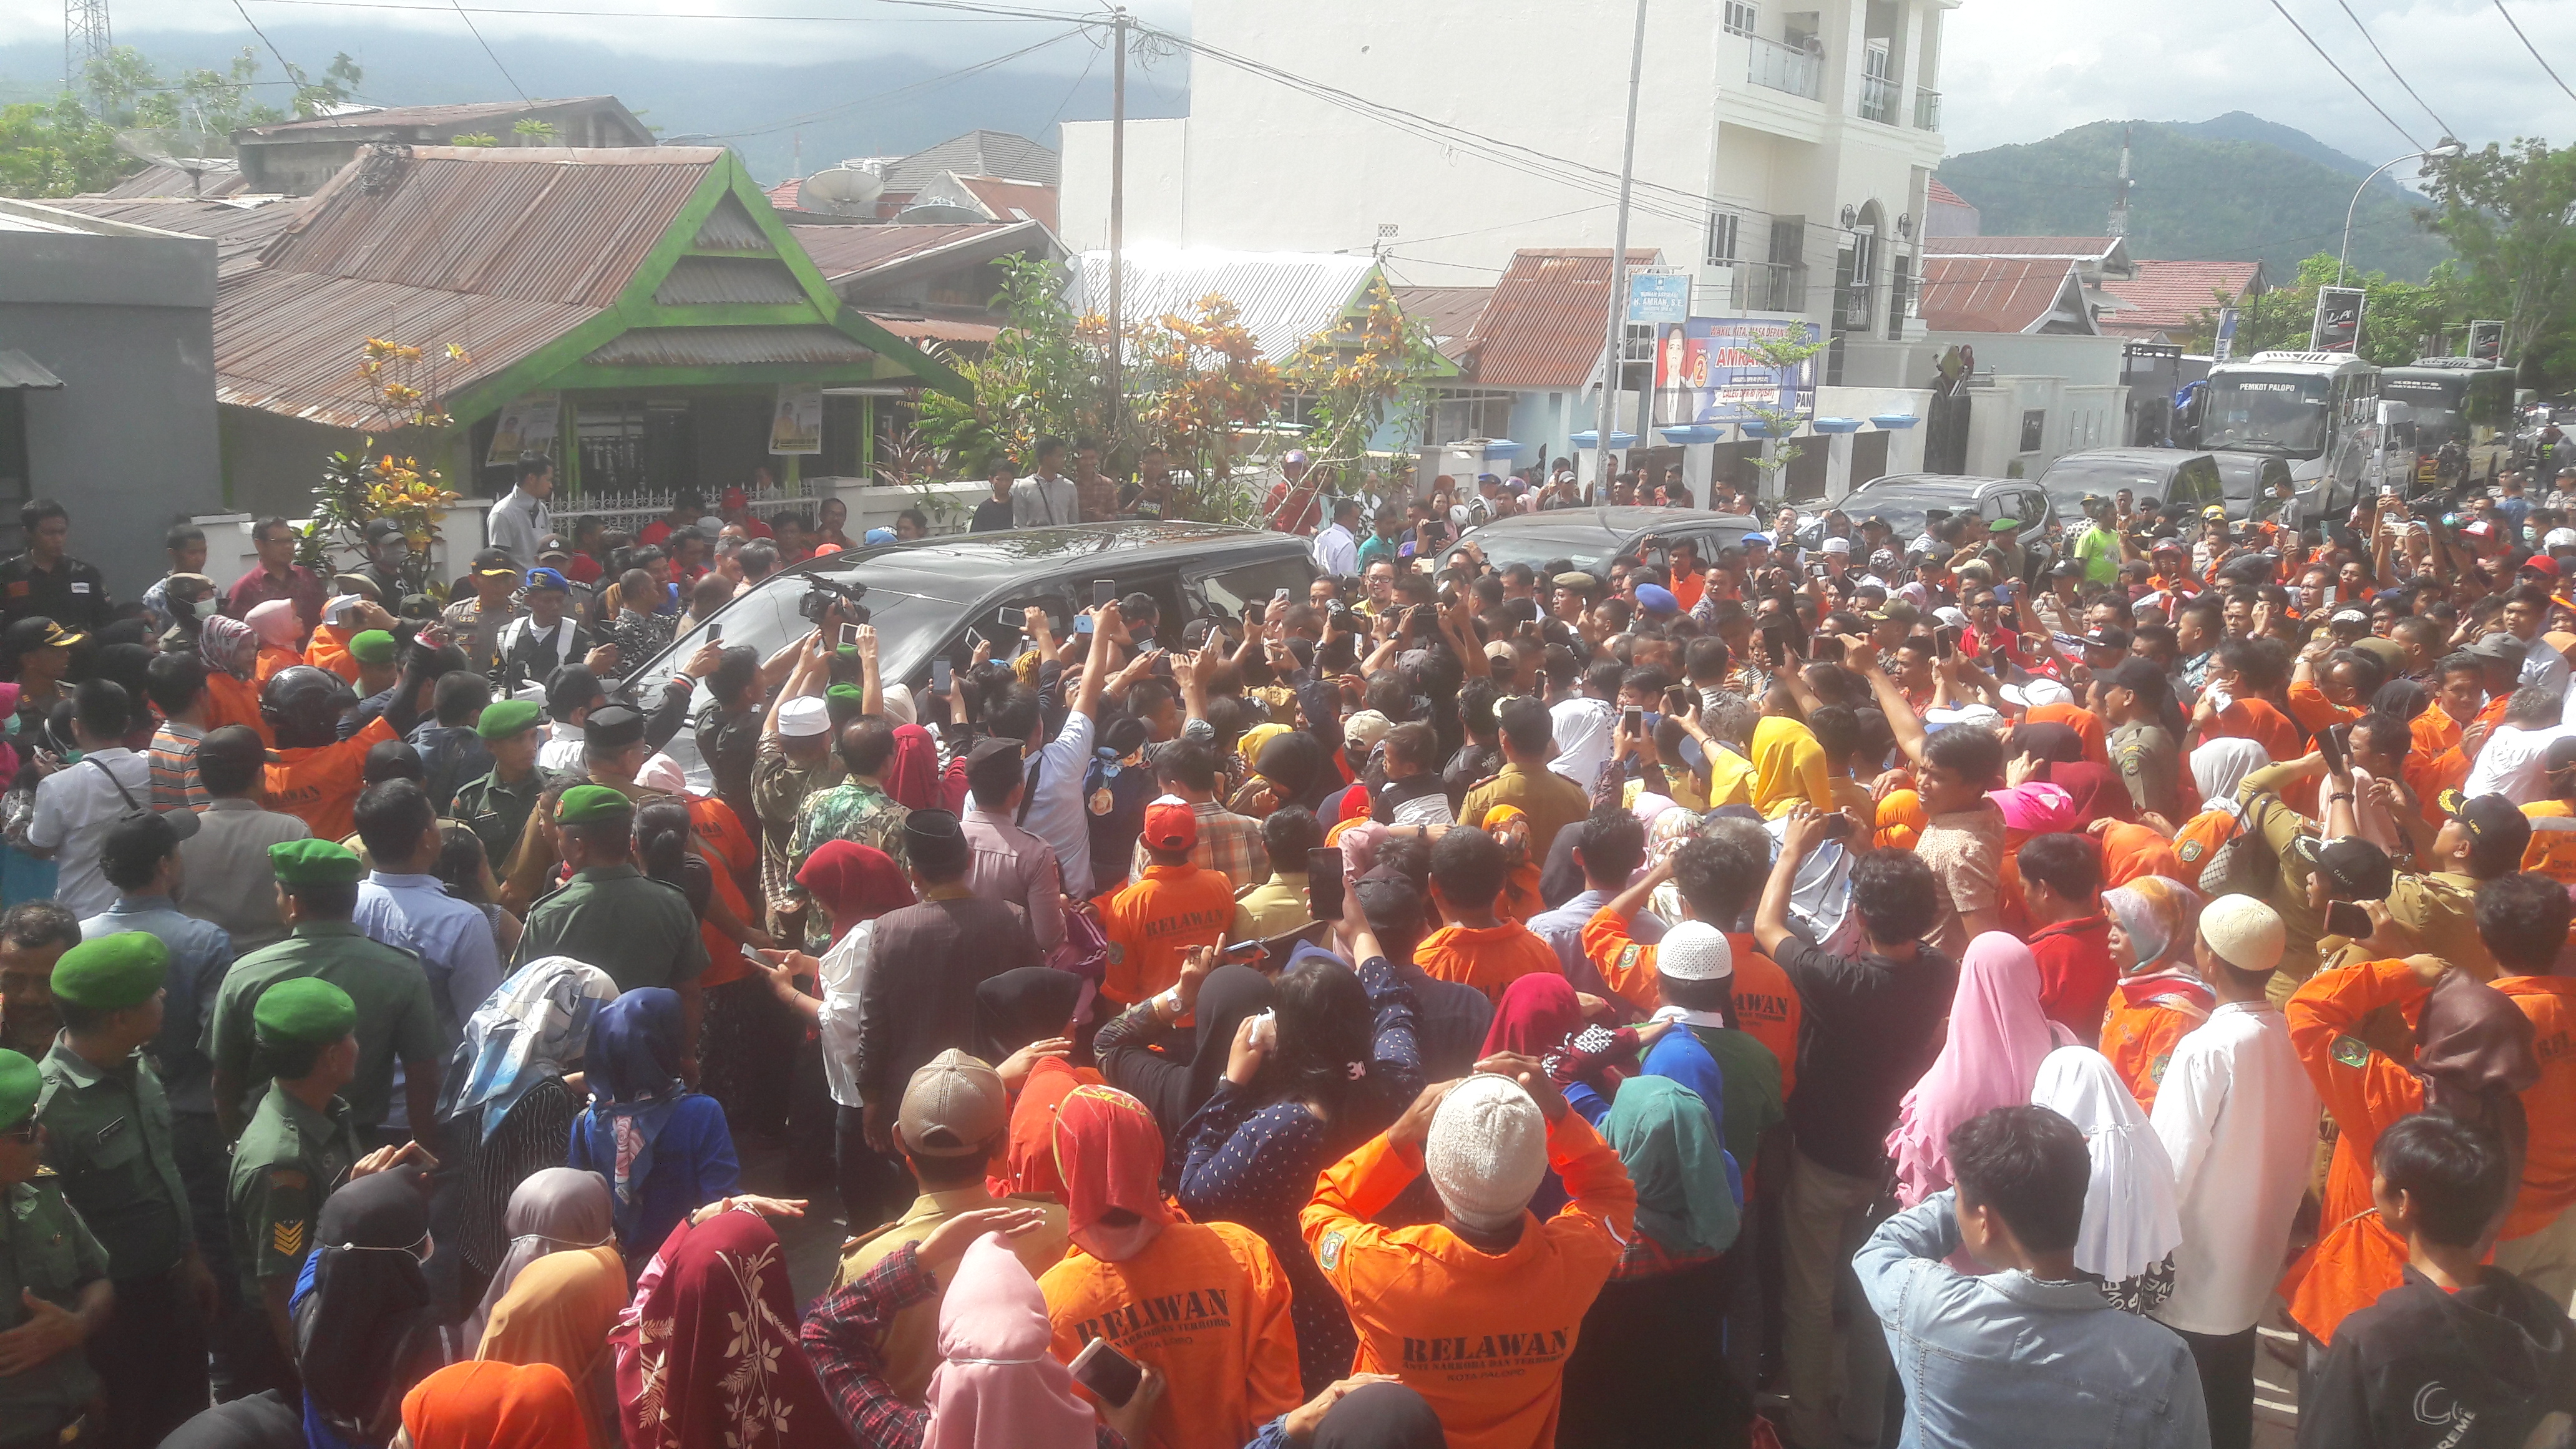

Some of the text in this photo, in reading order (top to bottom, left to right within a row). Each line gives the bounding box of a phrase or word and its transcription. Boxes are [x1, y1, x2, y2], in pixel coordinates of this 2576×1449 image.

[1710, 325, 1730, 337] WAKIL
[1696, 360, 1704, 381] 2
[2239, 383, 2295, 392] PEMKOT PALOPO
[1796, 393, 1812, 407] PAN
[1145, 909, 1224, 936] RELAWAN
[1403, 1327, 1570, 1362] RELAWAN
[1447, 1373, 1477, 1382] KOTA
